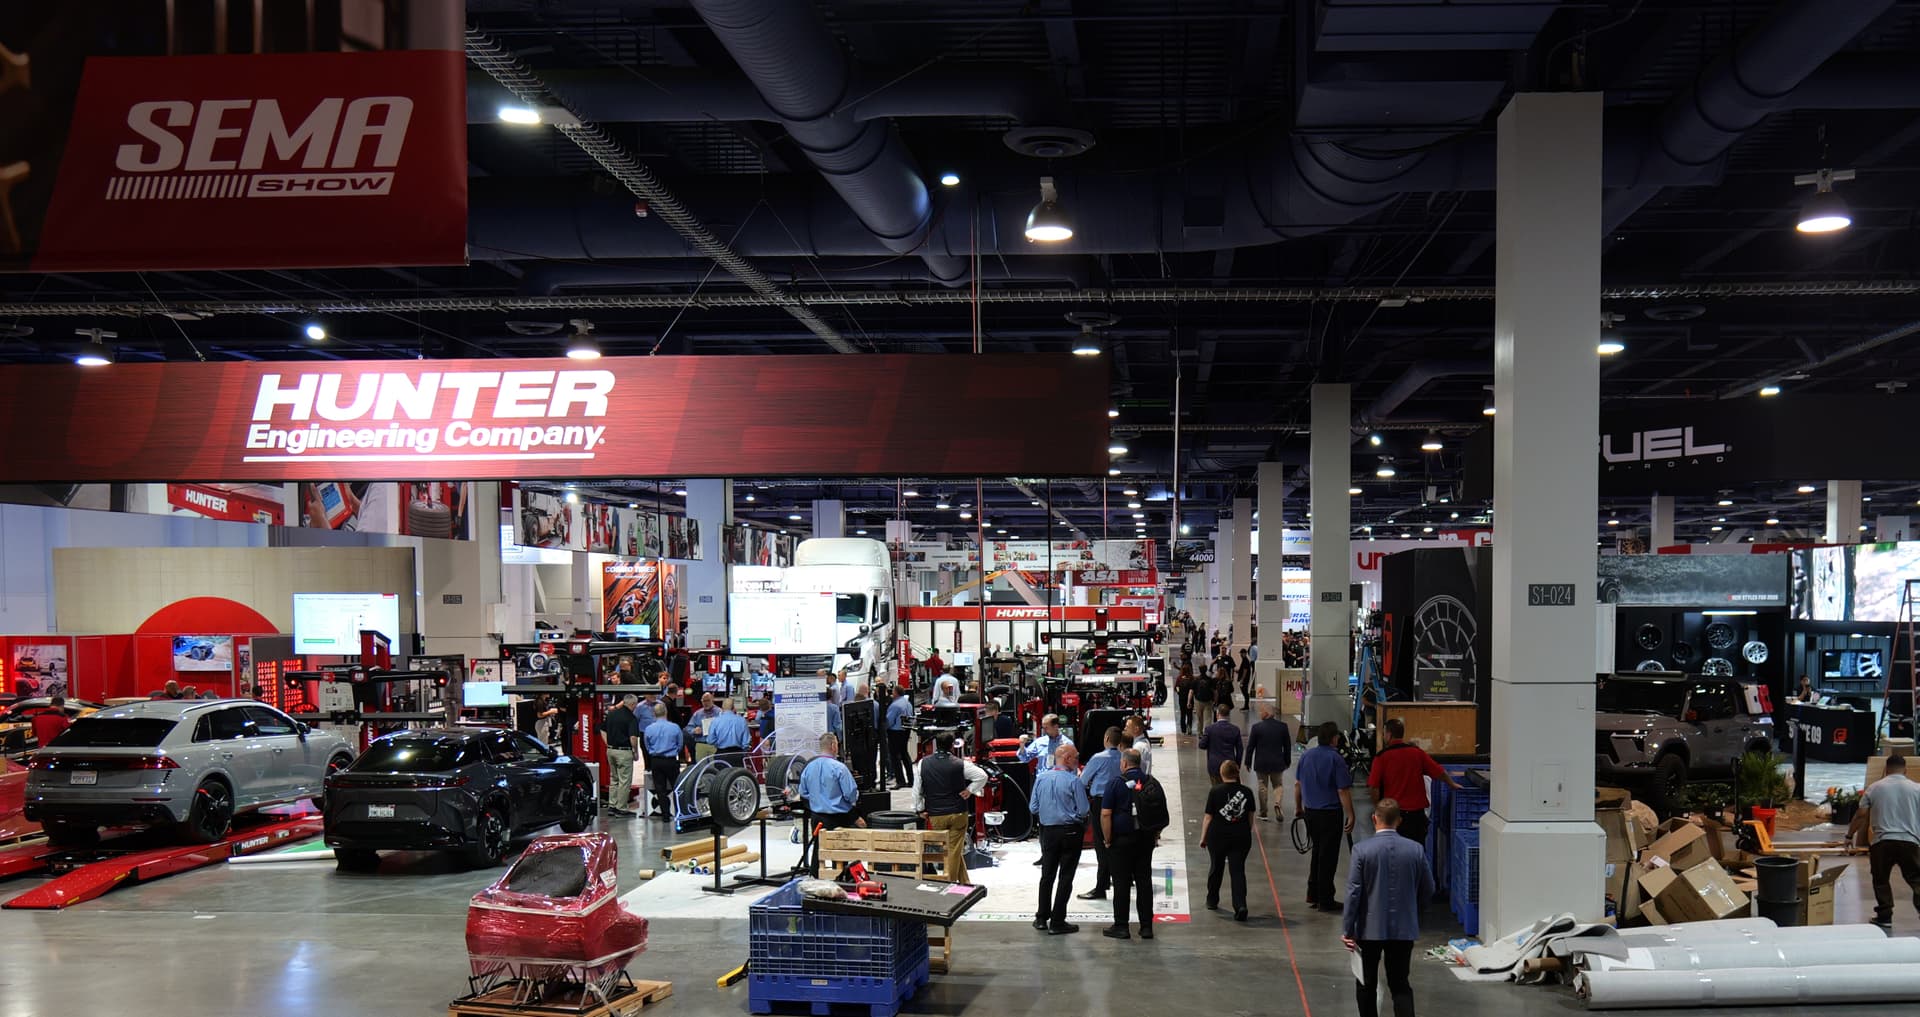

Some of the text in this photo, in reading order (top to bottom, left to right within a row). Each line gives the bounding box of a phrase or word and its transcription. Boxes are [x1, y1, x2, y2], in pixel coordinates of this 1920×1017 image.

[115, 96, 414, 172] SEMA
[256, 177, 387, 193] SHOW
[252, 369, 616, 421] HUNTER
[246, 422, 440, 454] Engineering
[185, 488, 228, 513] HUNTER
[1189, 553, 1214, 562] 44000
[1531, 587, 1573, 604] S1-024
[996, 608, 1050, 617] HUNTER
[242, 836, 269, 849] HUNTER
